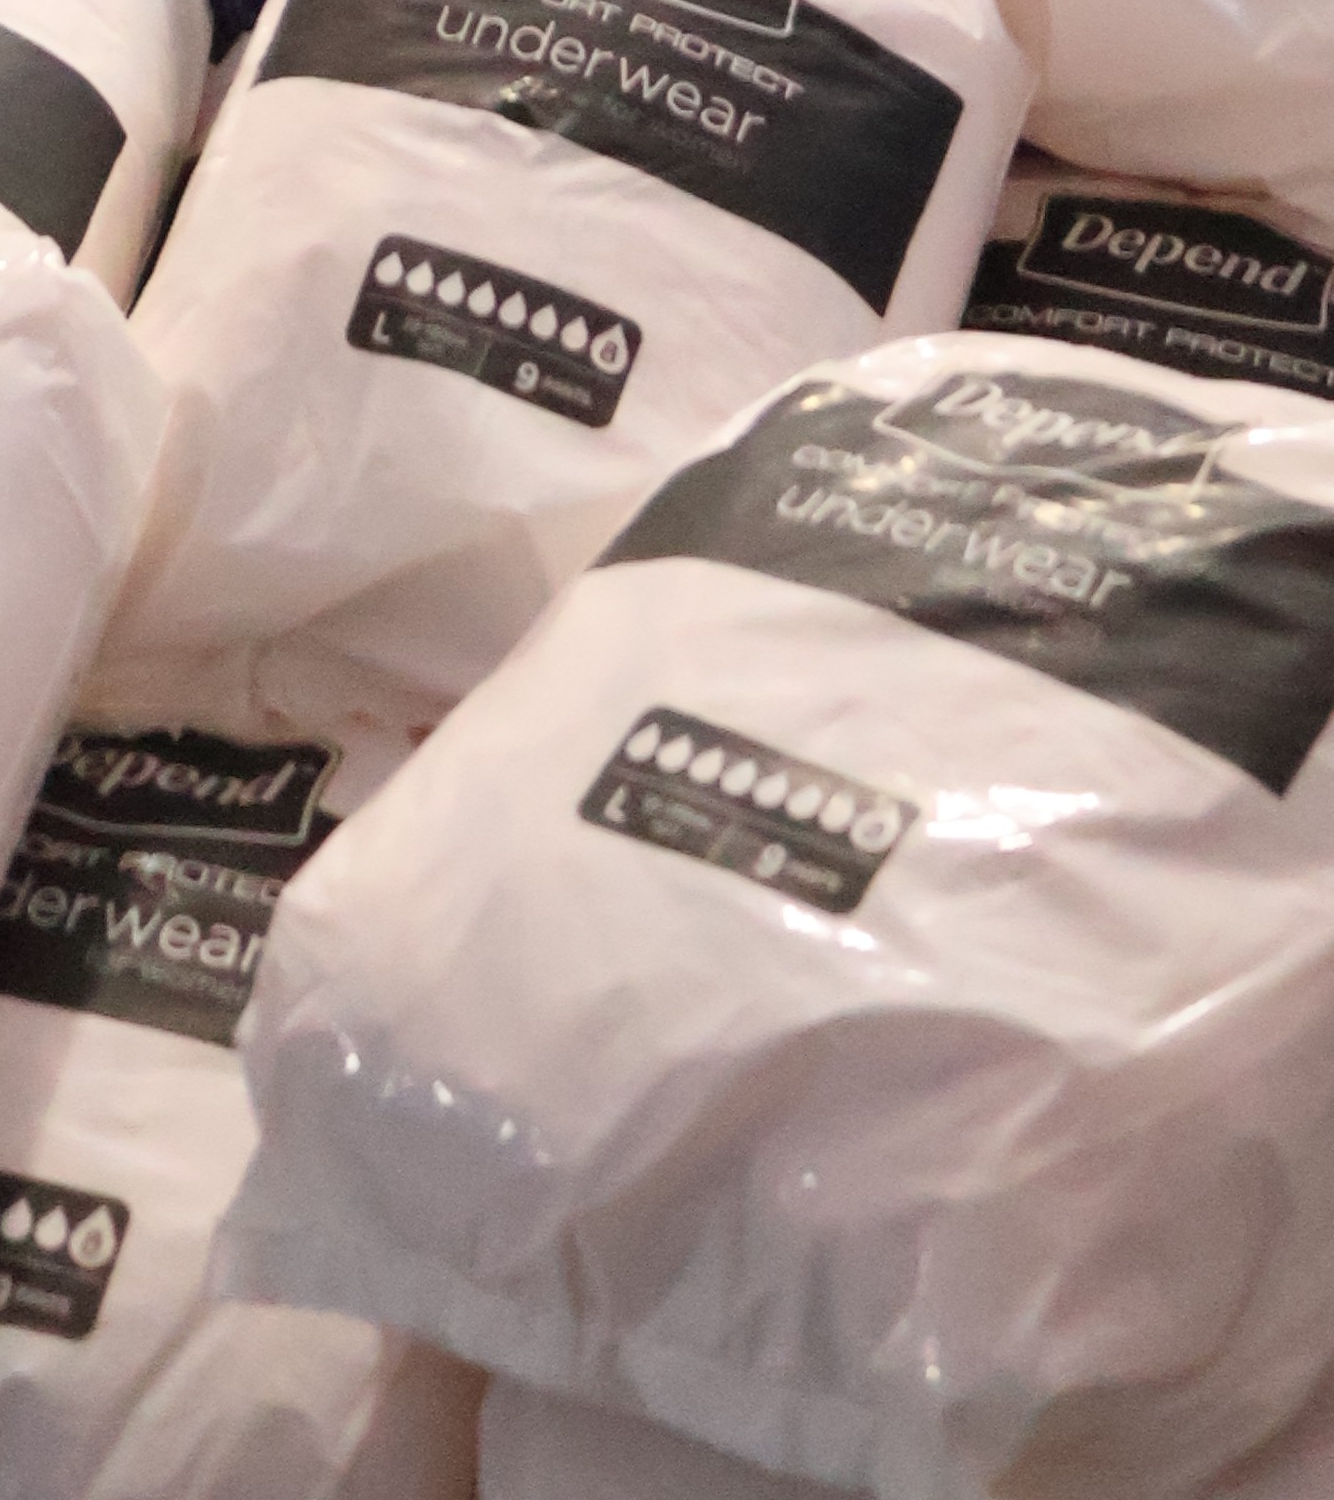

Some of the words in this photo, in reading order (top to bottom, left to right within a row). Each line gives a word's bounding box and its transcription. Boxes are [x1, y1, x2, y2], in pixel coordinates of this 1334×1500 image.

[436, 4, 765, 144] underwear
[629, 13, 805, 101] PROTECT
[1062, 213, 1308, 296] Depend
[372, 311, 391, 345] L
[776, 485, 1132, 608] underwear
